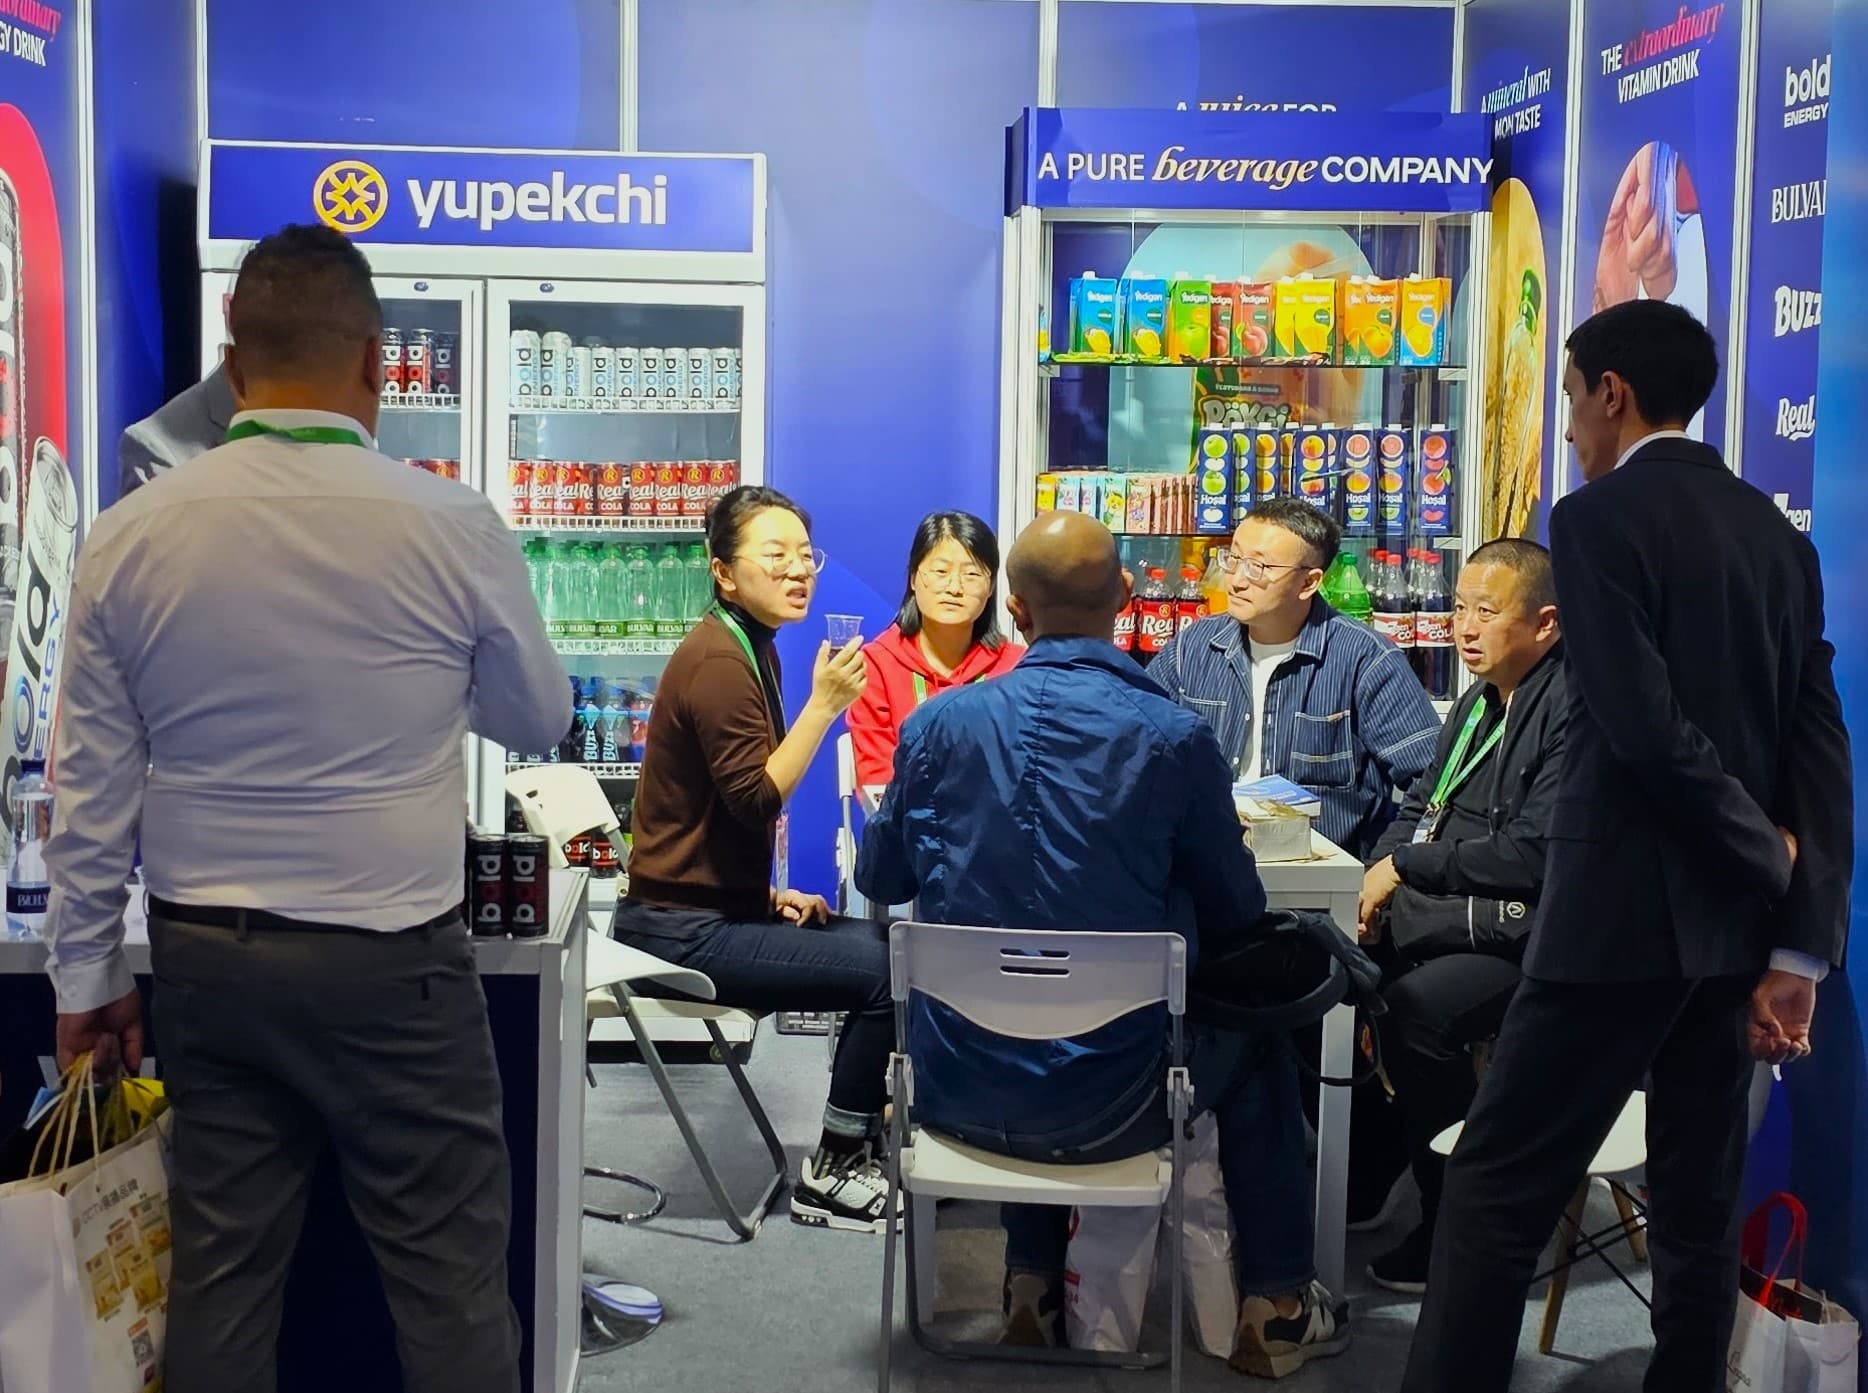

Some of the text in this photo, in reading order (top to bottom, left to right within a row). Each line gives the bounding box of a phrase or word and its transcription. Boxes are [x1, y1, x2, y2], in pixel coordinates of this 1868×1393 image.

[14, 27, 47, 67] DRINK
[1601, 3, 1724, 75] THE extraordinary
[1527, 67, 1551, 99] WITH
[1618, 49, 1701, 104] VITAMIN DRINK
[1784, 54, 1832, 107] bold
[1515, 104, 1541, 135] TASTE
[1783, 103, 1829, 128] ENERGY
[1038, 146, 1494, 191] A PURE beverage COMPANY
[407, 171, 667, 230] yupekchi
[1771, 179, 1827, 223] BULVA
[1774, 285, 1823, 337] BUZZ
[593, 357, 606, 397] bold
[619, 358, 632, 397] bold
[643, 358, 656, 397] bold
[664, 358, 676, 397] bold
[689, 358, 702, 398] bold
[715, 358, 728, 398] bold
[1775, 395, 1816, 441] Real
[597, 483, 624, 501] Rea
[601, 502, 623, 511] COLA
[681, 483, 708, 501] Rea
[1142, 615, 1174, 637] Rea
